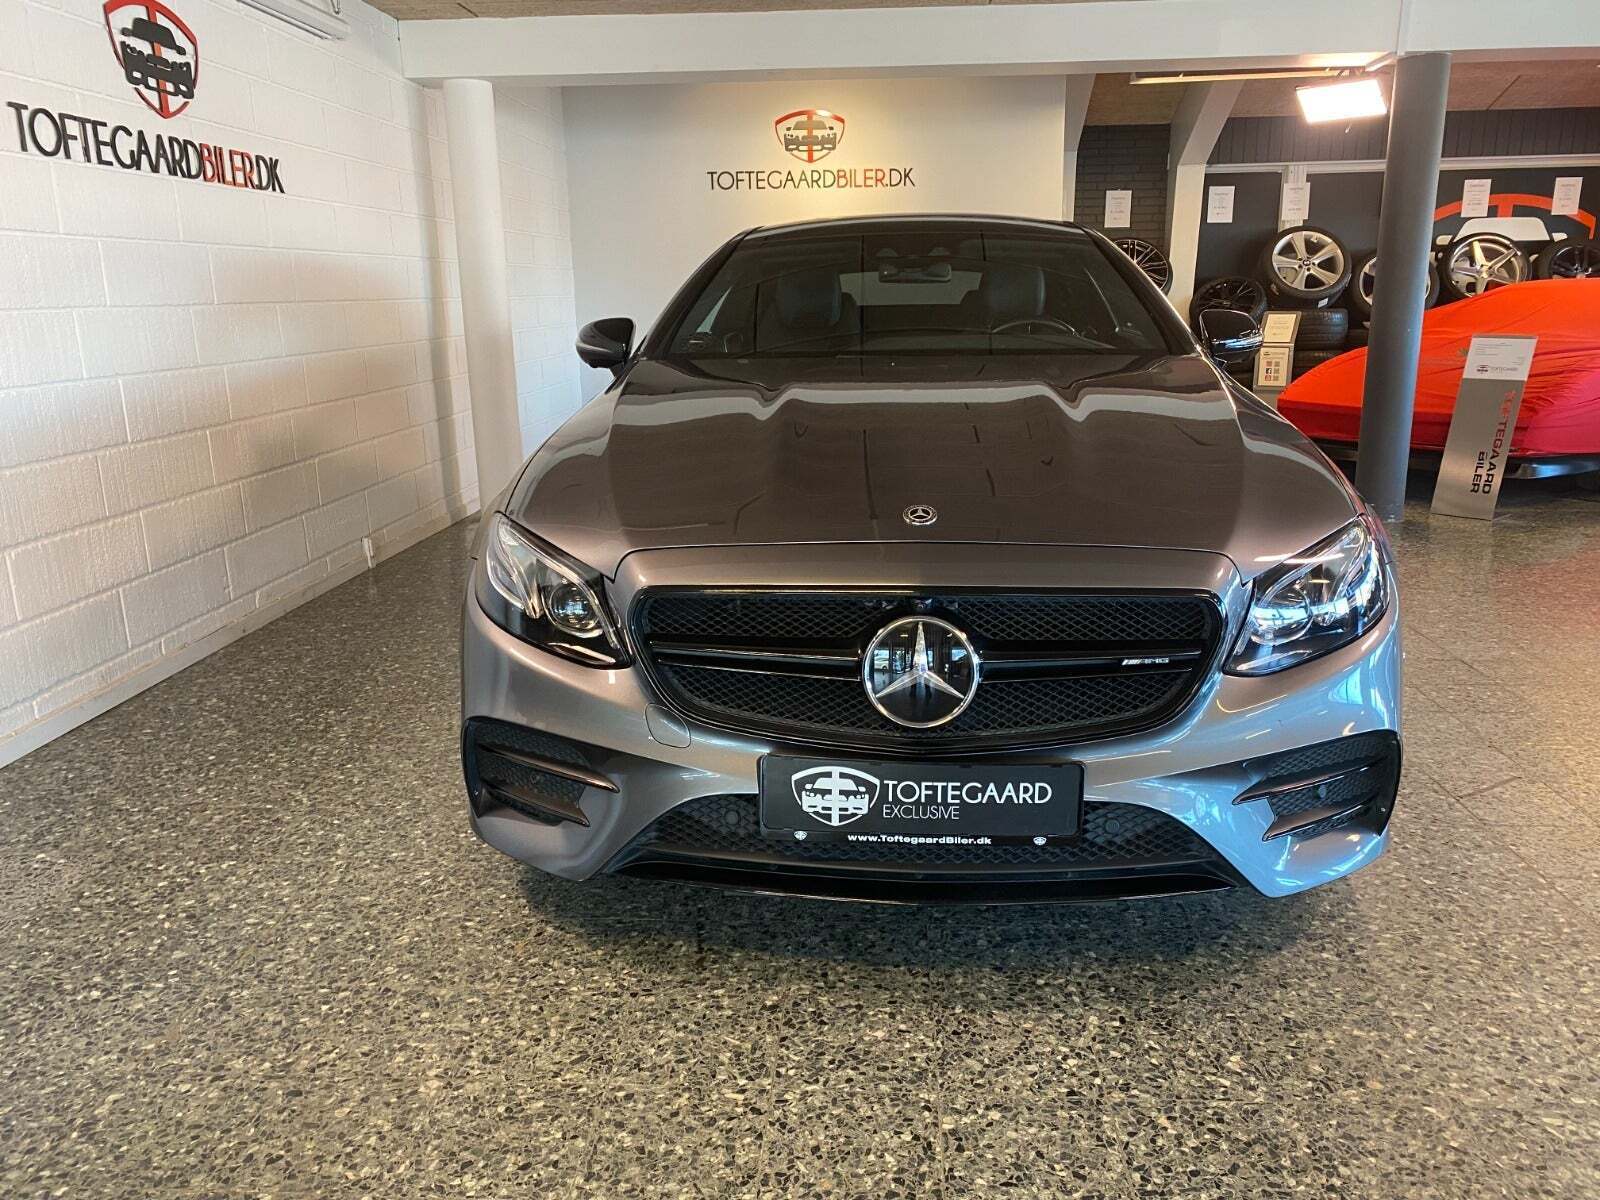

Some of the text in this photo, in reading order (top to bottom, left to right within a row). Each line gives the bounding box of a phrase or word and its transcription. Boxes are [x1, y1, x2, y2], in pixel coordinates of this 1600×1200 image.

[7, 101, 285, 193] TOFTEGAARDBILER.DK
[707, 167, 916, 190] TOFTEGAARDBILER.DK
[1470, 451, 1486, 493] BILER
[883, 780, 1052, 804] TOFTEGAARD
[883, 804, 960, 820] EXCLUSIVE
[847, 834, 992, 845] www.ToftegaardBiler.dk
